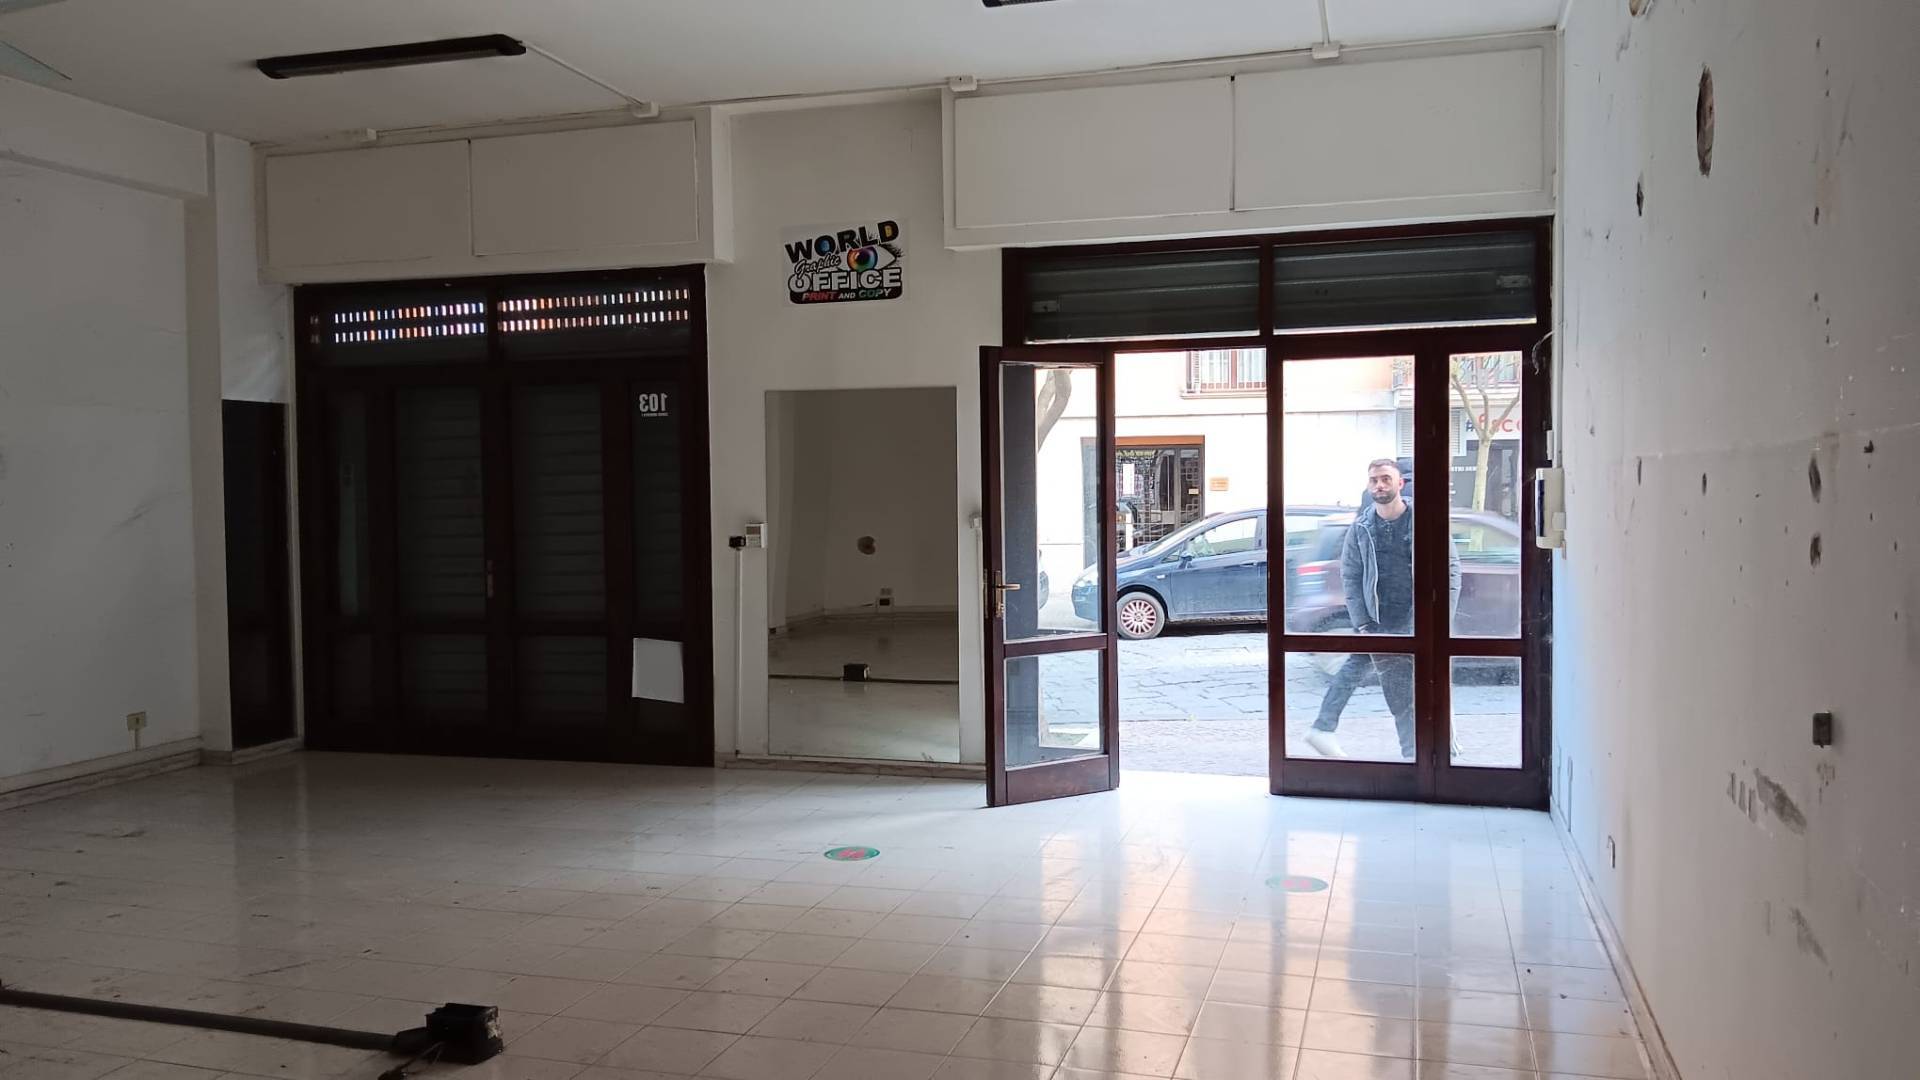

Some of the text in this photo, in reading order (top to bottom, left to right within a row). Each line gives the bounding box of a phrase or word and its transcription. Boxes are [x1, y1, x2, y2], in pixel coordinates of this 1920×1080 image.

[785, 220, 899, 263] WORLD
[794, 252, 841, 279] Graphic
[788, 267, 902, 293] OFFICE
[802, 291, 837, 300] PRINT
[858, 288, 892, 298] COPY
